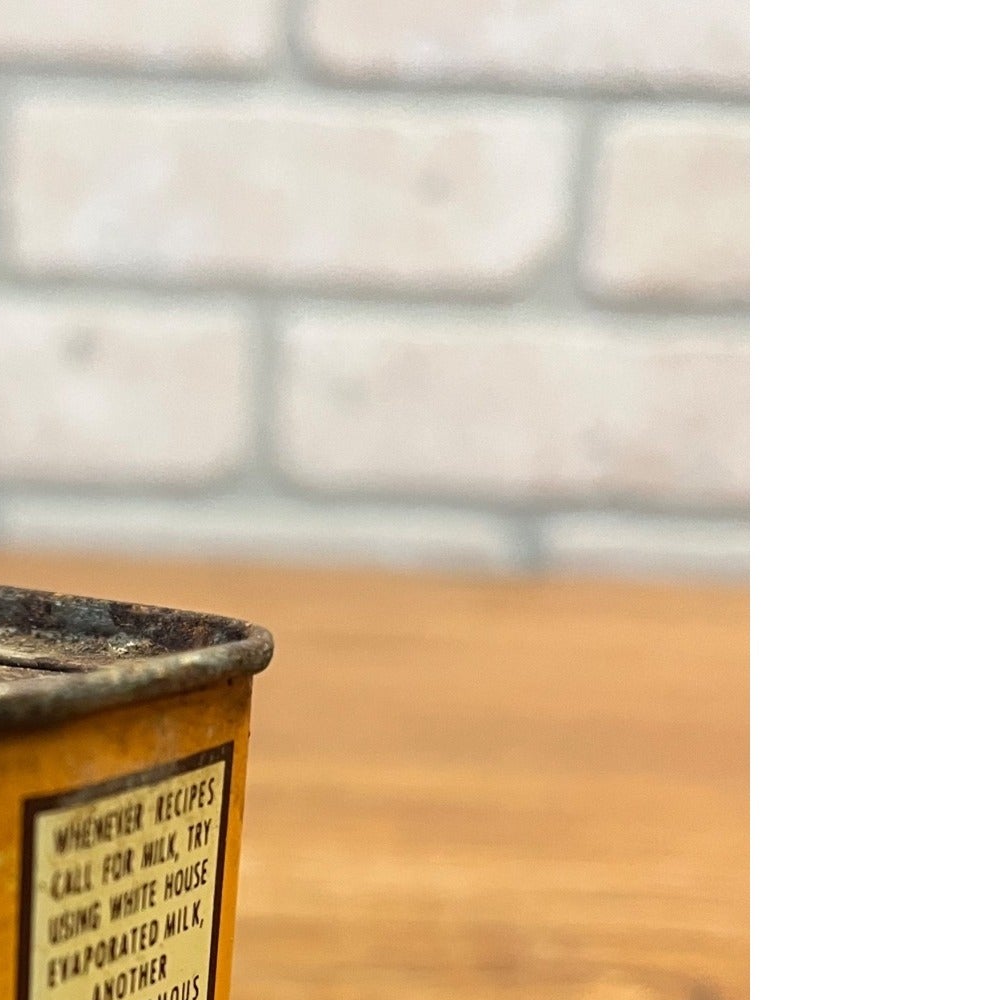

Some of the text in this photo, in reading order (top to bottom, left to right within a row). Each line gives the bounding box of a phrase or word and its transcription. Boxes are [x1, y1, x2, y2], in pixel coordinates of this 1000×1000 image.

[55, 777, 215, 854] WHENEVER RECIPES
[51, 818, 212, 900] CALL FOR MILK, TRY
[48, 858, 208, 945] USING WHITE HOUSE
[48, 900, 204, 988] EVAPORATED MILK,
